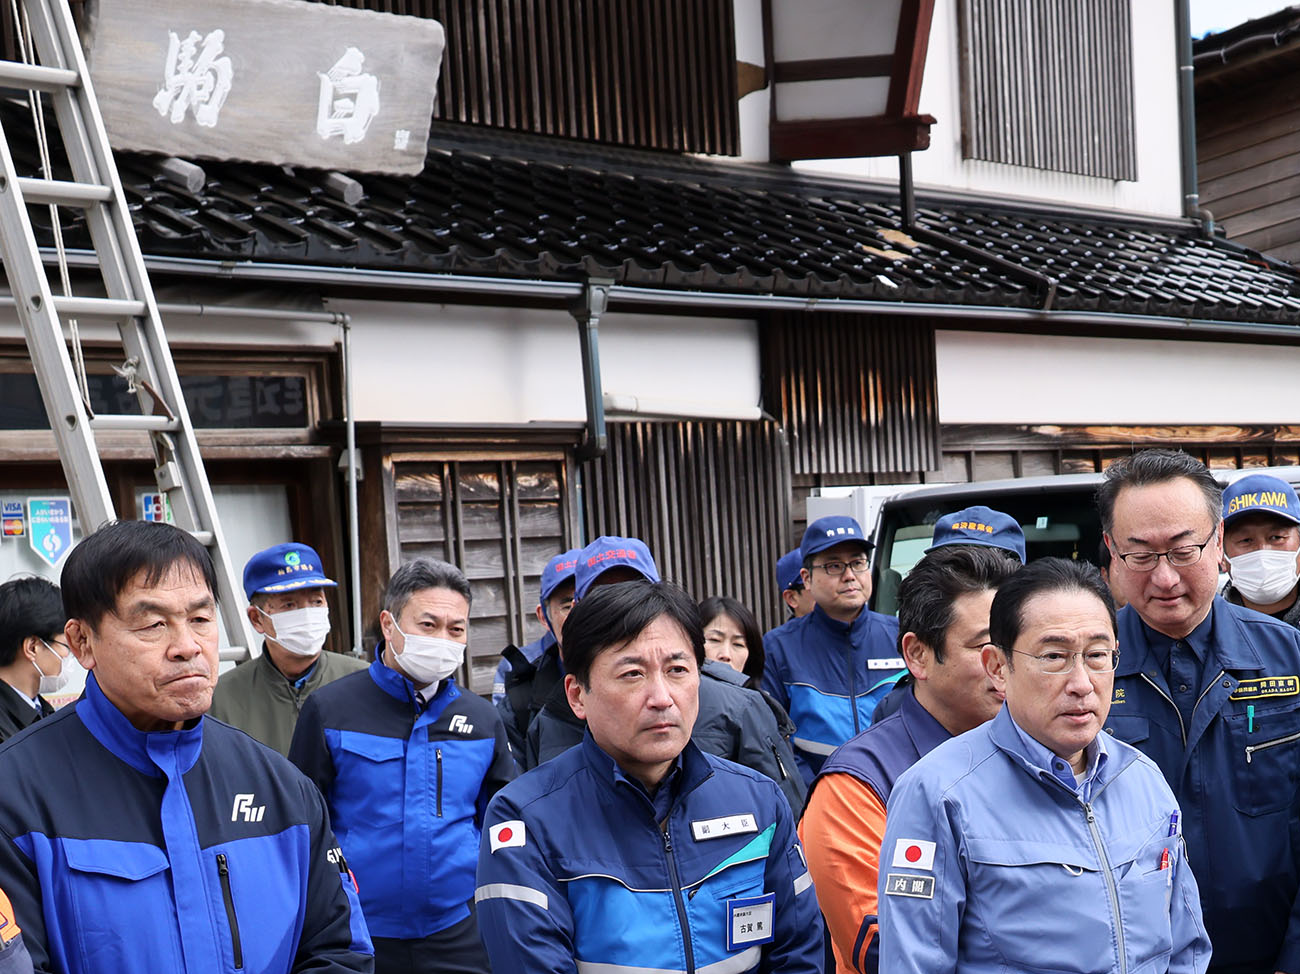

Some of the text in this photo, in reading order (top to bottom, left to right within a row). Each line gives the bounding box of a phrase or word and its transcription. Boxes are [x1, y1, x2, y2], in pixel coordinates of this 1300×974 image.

[4, 502, 22, 511] VISA
[1228, 491, 1288, 514] ISHIKAWA
[587, 549, 637, 568] 国土交通省
[702, 819, 749, 834] 副大臣
[894, 878, 925, 893] 内閣
